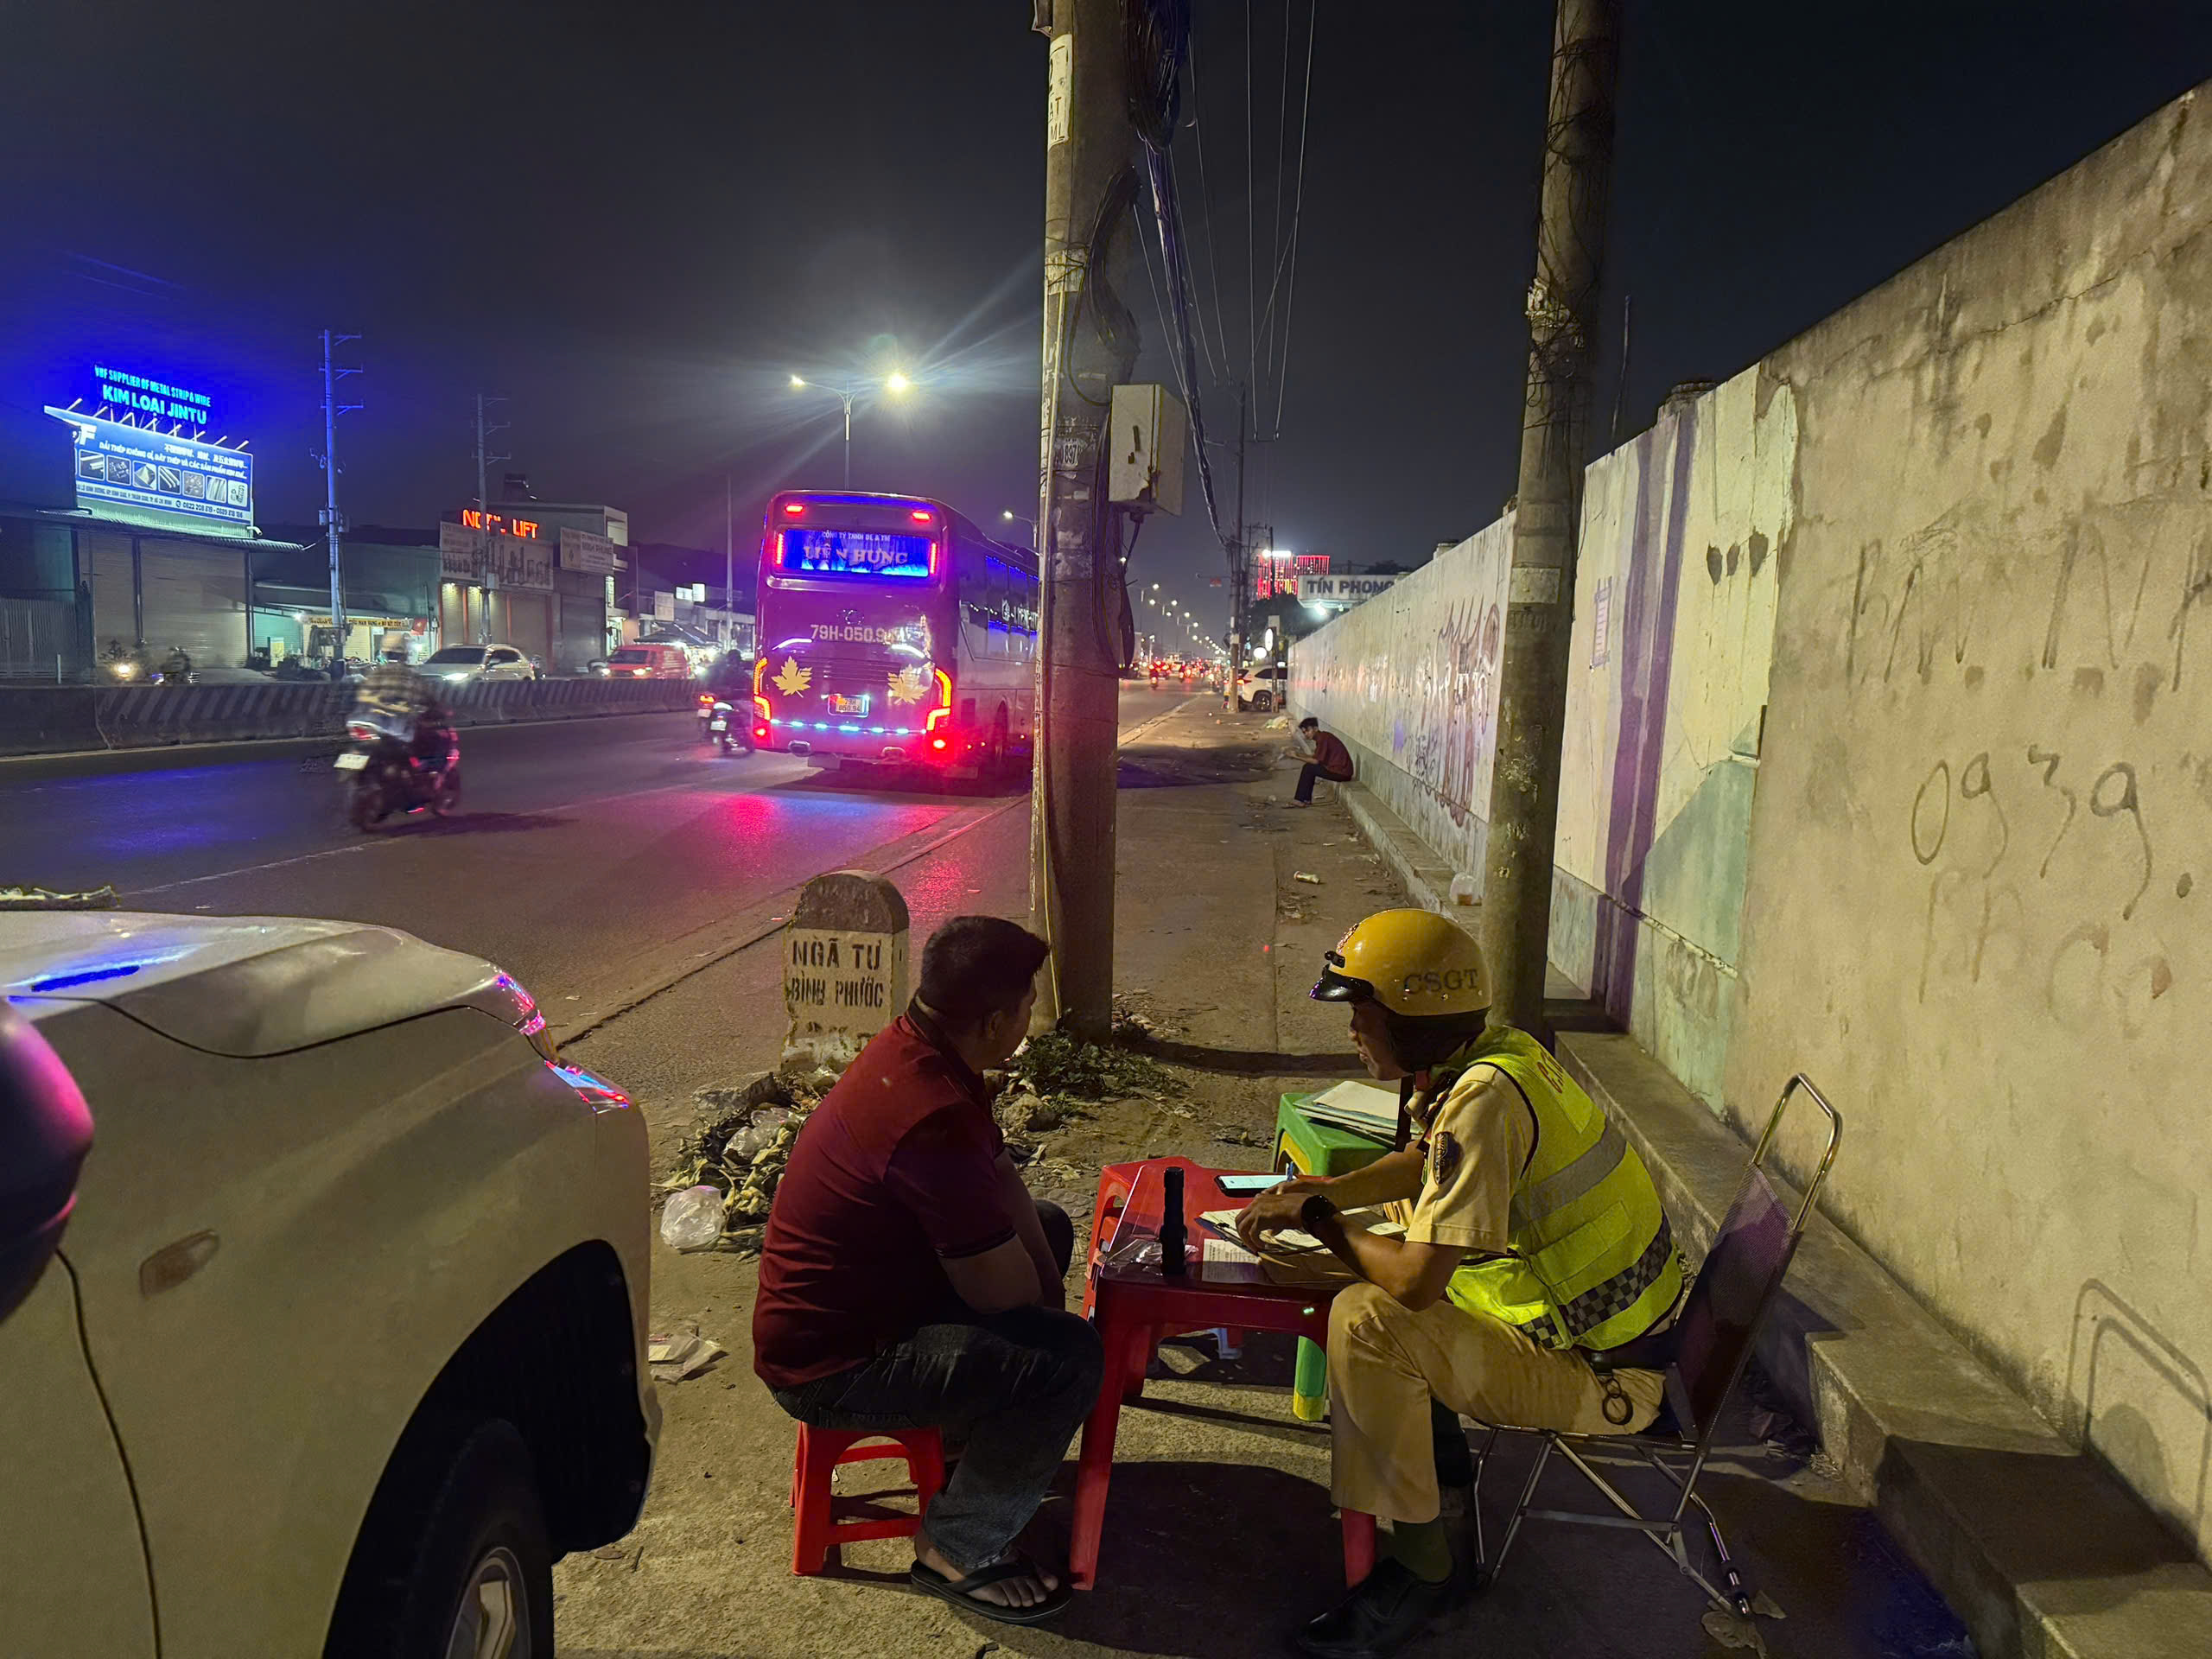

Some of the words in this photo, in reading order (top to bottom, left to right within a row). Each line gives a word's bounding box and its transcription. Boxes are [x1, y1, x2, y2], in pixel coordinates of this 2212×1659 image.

[103, 384, 130, 405] KIM
[131, 391, 165, 416] LOẠI
[167, 402, 207, 424] JINTU
[1307, 577, 1333, 594] TÍN
[792, 938, 840, 969] NGÃ
[852, 939, 882, 970] TƯ
[835, 975, 884, 1008] PHƯỚC
[1403, 968, 1478, 995] CSGT
